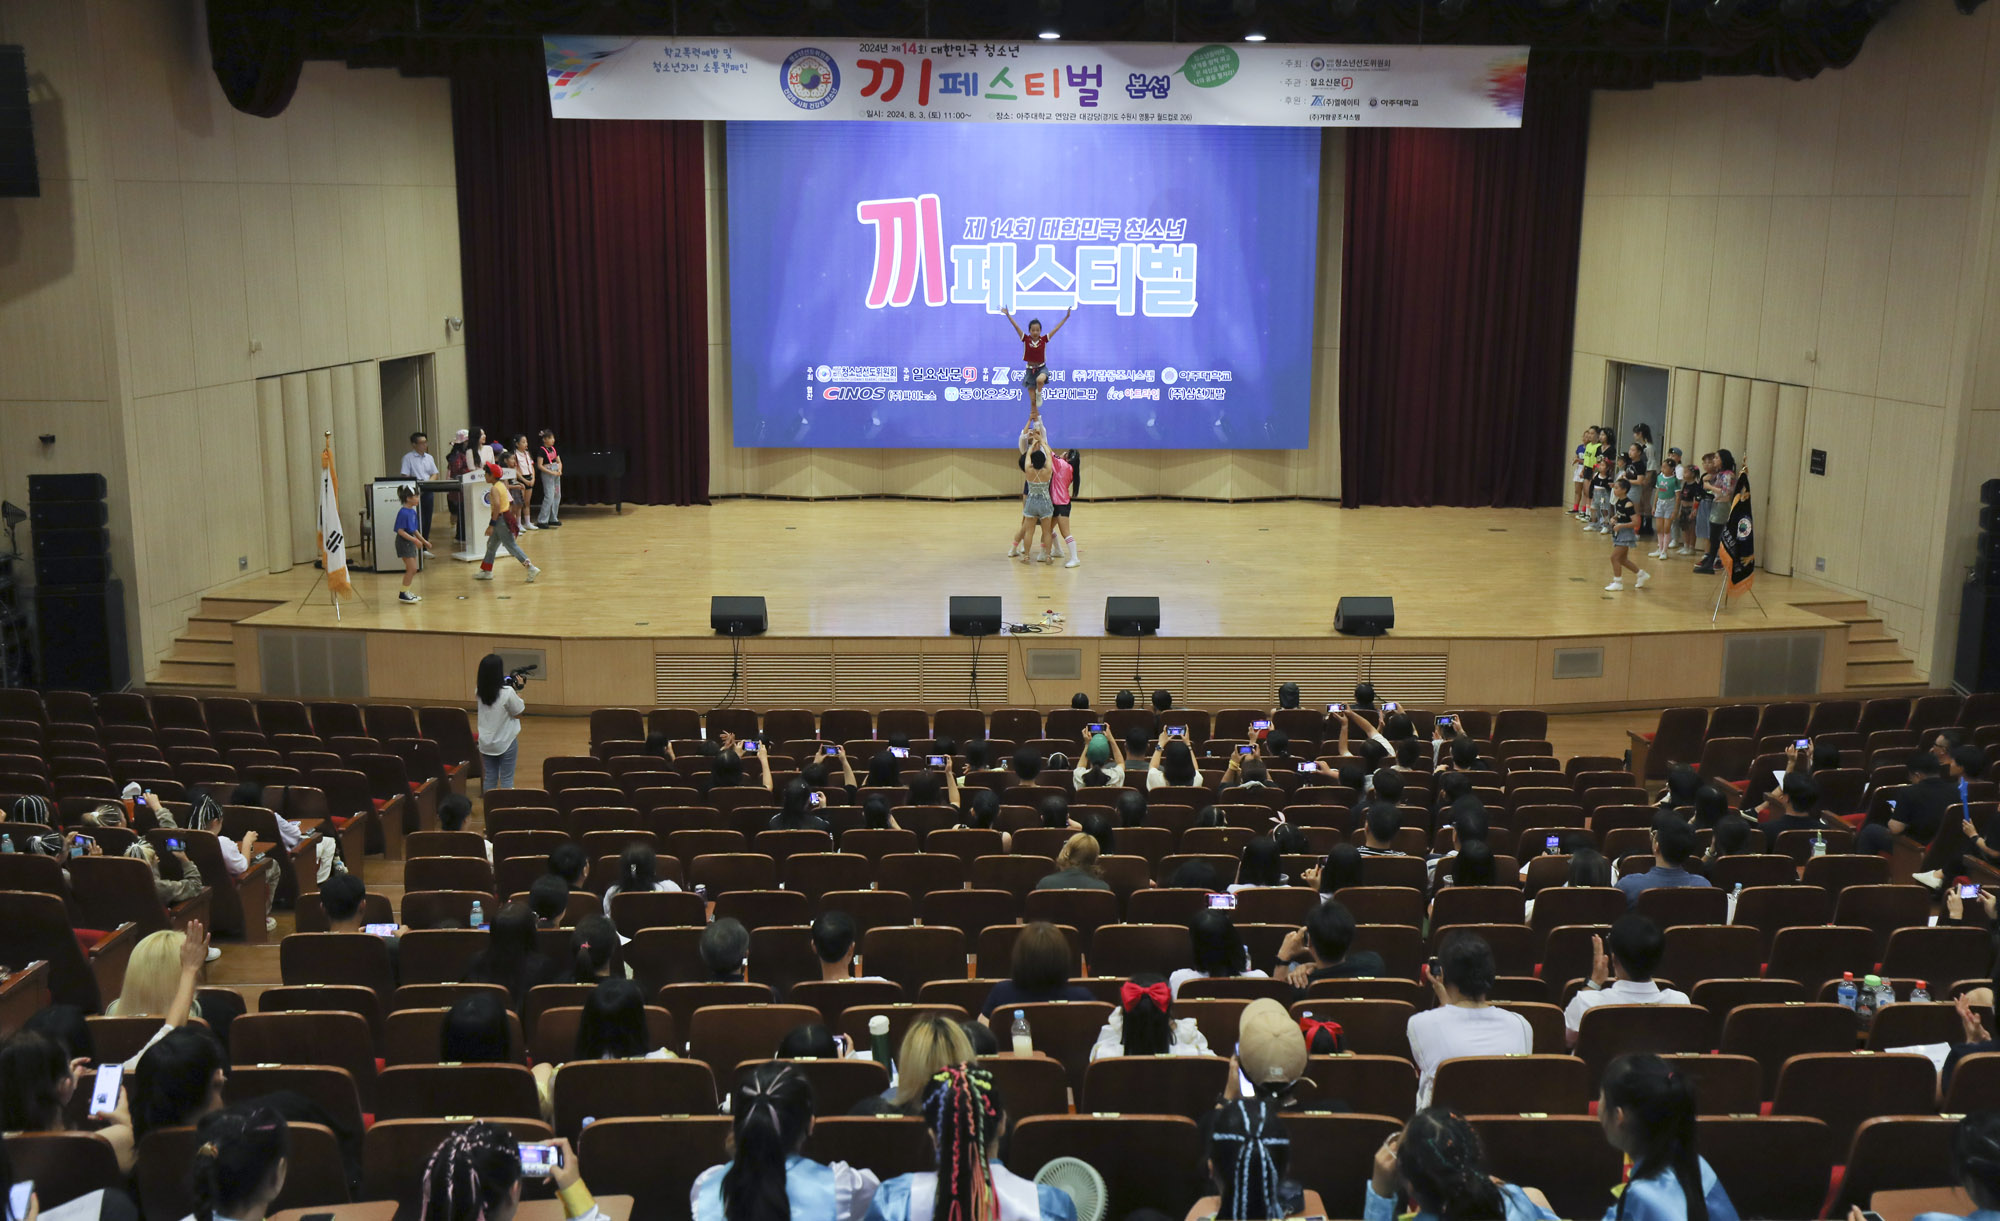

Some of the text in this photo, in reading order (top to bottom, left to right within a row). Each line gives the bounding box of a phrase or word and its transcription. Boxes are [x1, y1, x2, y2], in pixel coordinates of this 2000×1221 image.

[664, 46, 732, 60] 학교폭력예방 및
[859, 42, 1020, 58] 2024년 제14회 대한민국 청소년
[653, 61, 748, 73] 청소년과의 소통캠페인
[1335, 58, 1391, 68] 청소년선도위원회
[857, 58, 1103, 107] 끼 페스티벌
[1125, 73, 1170, 99] 본선
[1284, 78, 1341, 87] 주관 일요신문
[1381, 99, 1419, 107] 아주대학교
[866, 110, 883, 118] 일시:
[886, 110, 907, 118] 2024.
[928, 111, 941, 119] (토)
[996, 112, 1013, 120] 장소:
[1120, 113, 1137, 121] 수원시
[1139, 113, 1155, 121] 영통구
[963, 217, 1187, 241] 제 14회 대한민국 청소년
[857, 193, 948, 309] 끼
[950, 242, 1198, 317] 페스티벌
[841, 366, 897, 378] 청소년선도위원회
[912, 367, 963, 382] 일요신문
[1179, 370, 1232, 382] 아주대학교
[823, 386, 886, 400] CINOS
[960, 387, 1022, 401] 동아오츠카
